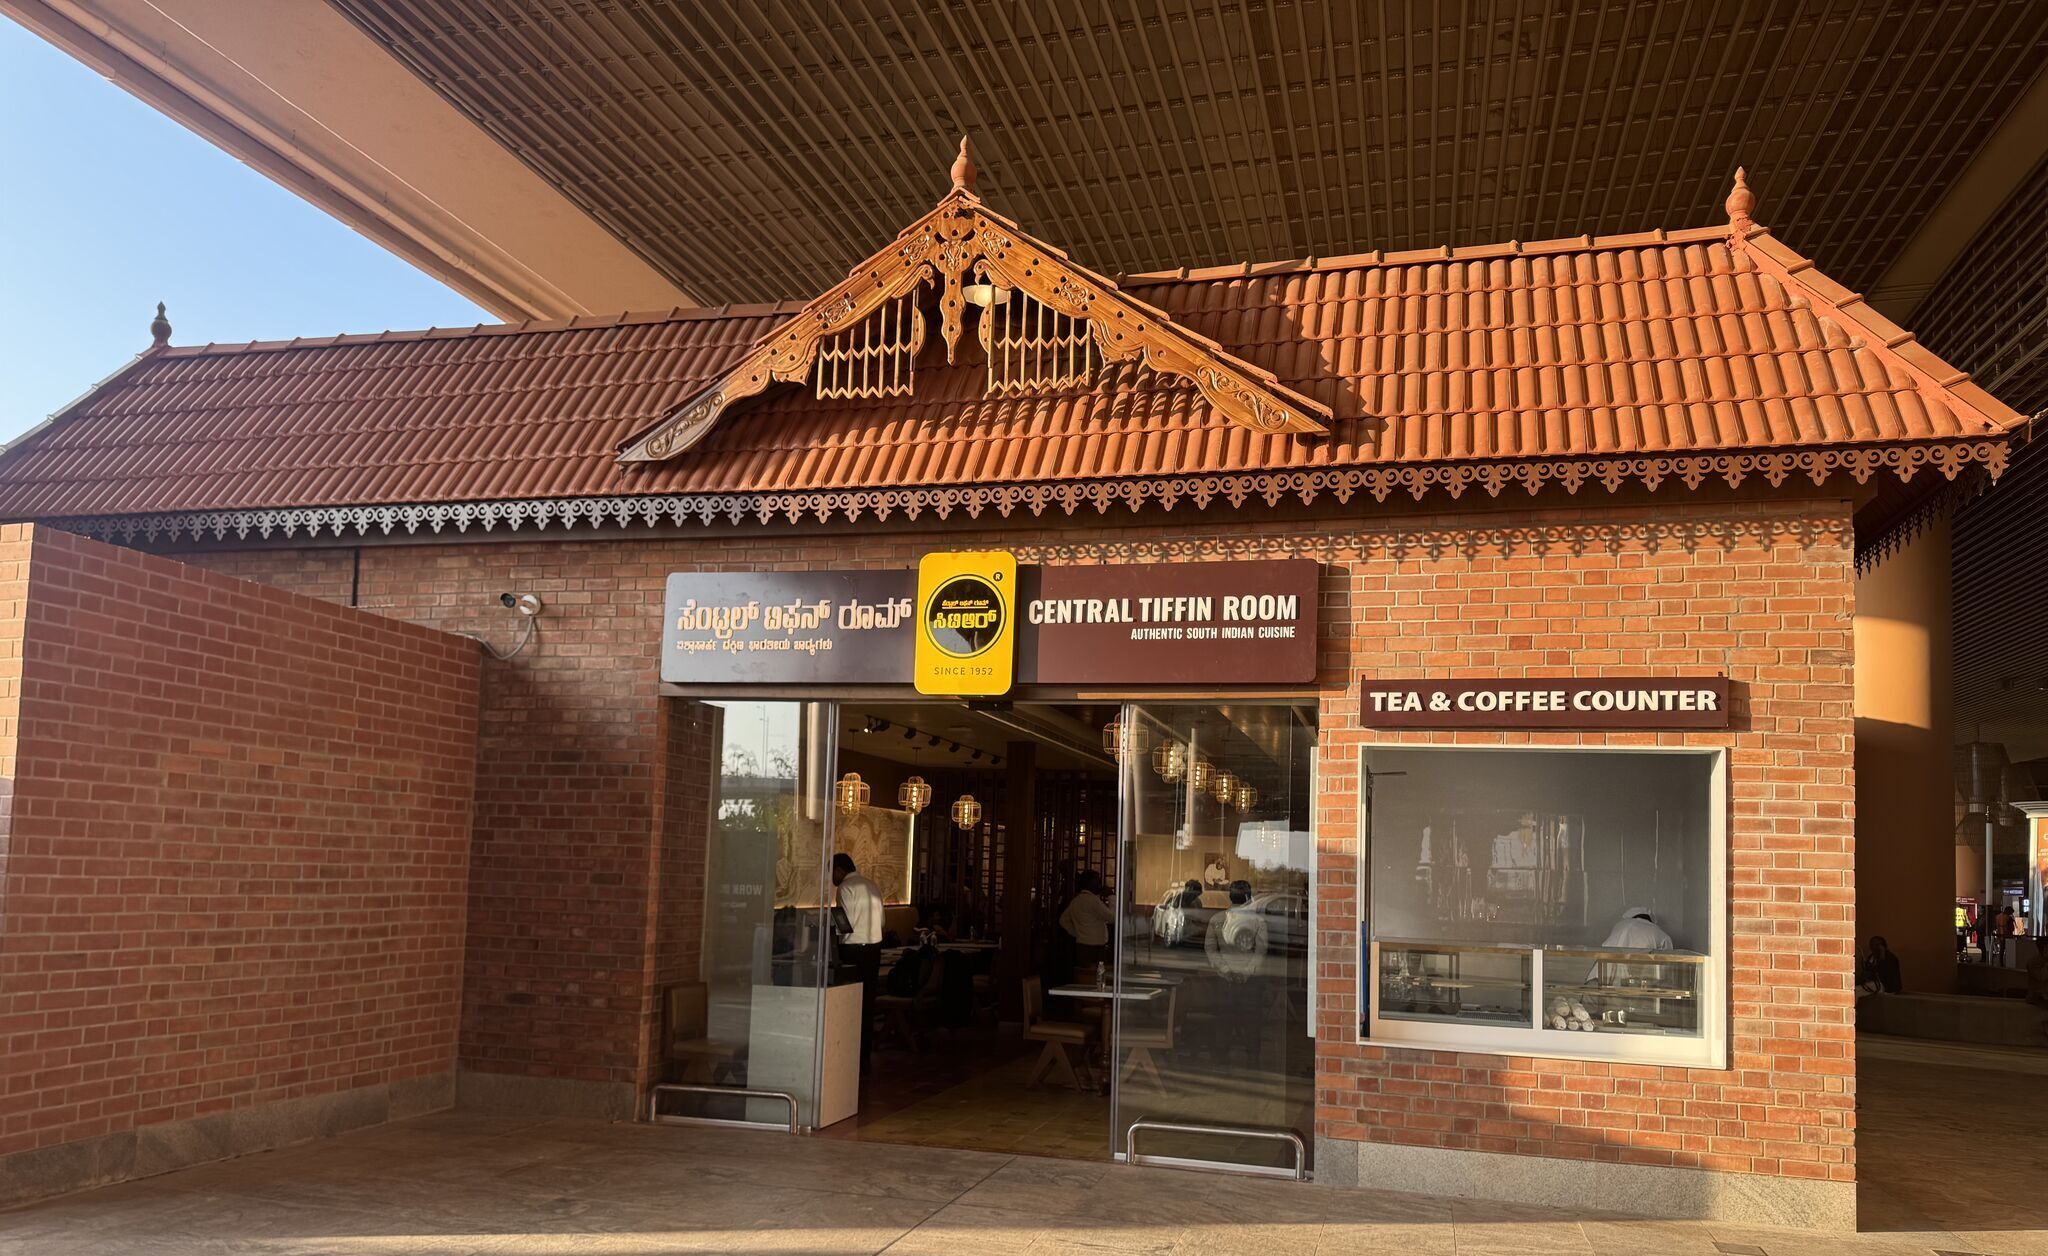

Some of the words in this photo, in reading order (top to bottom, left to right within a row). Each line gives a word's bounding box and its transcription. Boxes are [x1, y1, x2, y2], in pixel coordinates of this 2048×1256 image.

[677, 599, 760, 639] ಸೆಂಟ್ರಲ್
[763, 598, 831, 635] ಟಿಫನ್
[838, 597, 912, 630] ರೂಮ್
[933, 610, 997, 629] ಸಿಟಿಆರ್
[1028, 598, 1134, 625] CENTRAL
[1139, 596, 1213, 622] TIFFIN
[1223, 594, 1298, 621] ROOM
[1130, 628, 1183, 640] AUTHENTIC
[1186, 627, 1218, 639] SOUTH
[1221, 627, 1254, 639] INDIAN
[1258, 626, 1296, 638] CUISINE
[934, 667, 966, 675] SINCE
[970, 667, 993, 675] 1952
[1370, 691, 1421, 712] TEA
[1429, 691, 1451, 712] &
[1457, 690, 1566, 712] COFFEE
[1573, 690, 1717, 711] COUNTER
